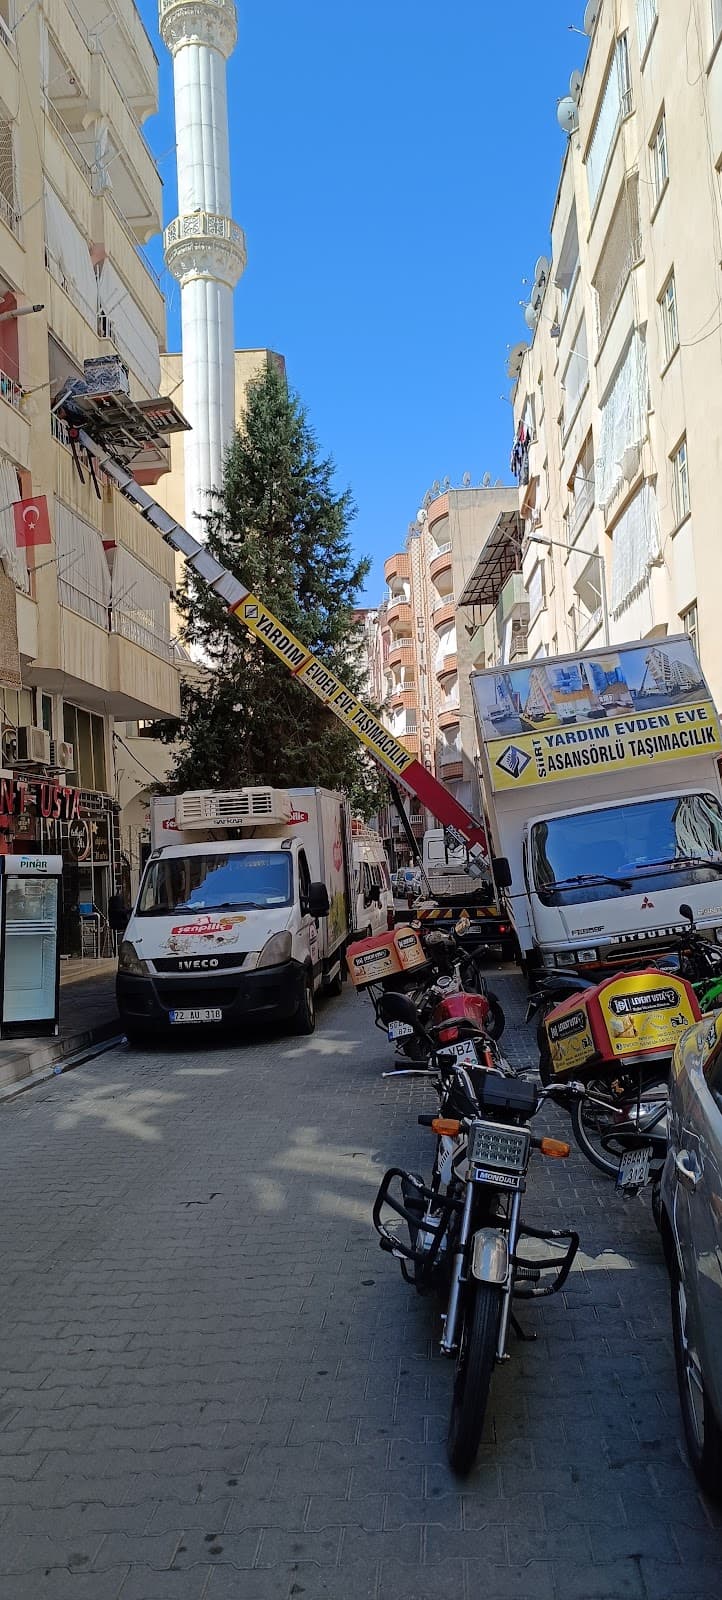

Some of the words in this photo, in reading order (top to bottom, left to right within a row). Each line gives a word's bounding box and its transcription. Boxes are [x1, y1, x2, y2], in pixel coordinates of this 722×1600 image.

[255, 614, 306, 666] YARDIM
[305, 662, 340, 698] EVDEN
[333, 692, 358, 715] EVE
[351, 710, 411, 770] TAŞIMACILIK
[544, 725, 610, 748] YARDIM
[614, 714, 670, 736] EVDEN
[675, 707, 708, 725] EVE
[547, 739, 625, 772] ASANSÖRLÜ
[628, 726, 716, 758] TAŞIMACILIK
[41, 783, 81, 819] USTA
[178, 958, 219, 969] IVECO
[631, 993, 651, 1006] LEVENT
[174, 1011, 184, 1021] 72
[190, 1010, 200, 1020] AU
[479, 1171, 516, 1185] MONDIAL
[628, 1167, 644, 1181] 312
